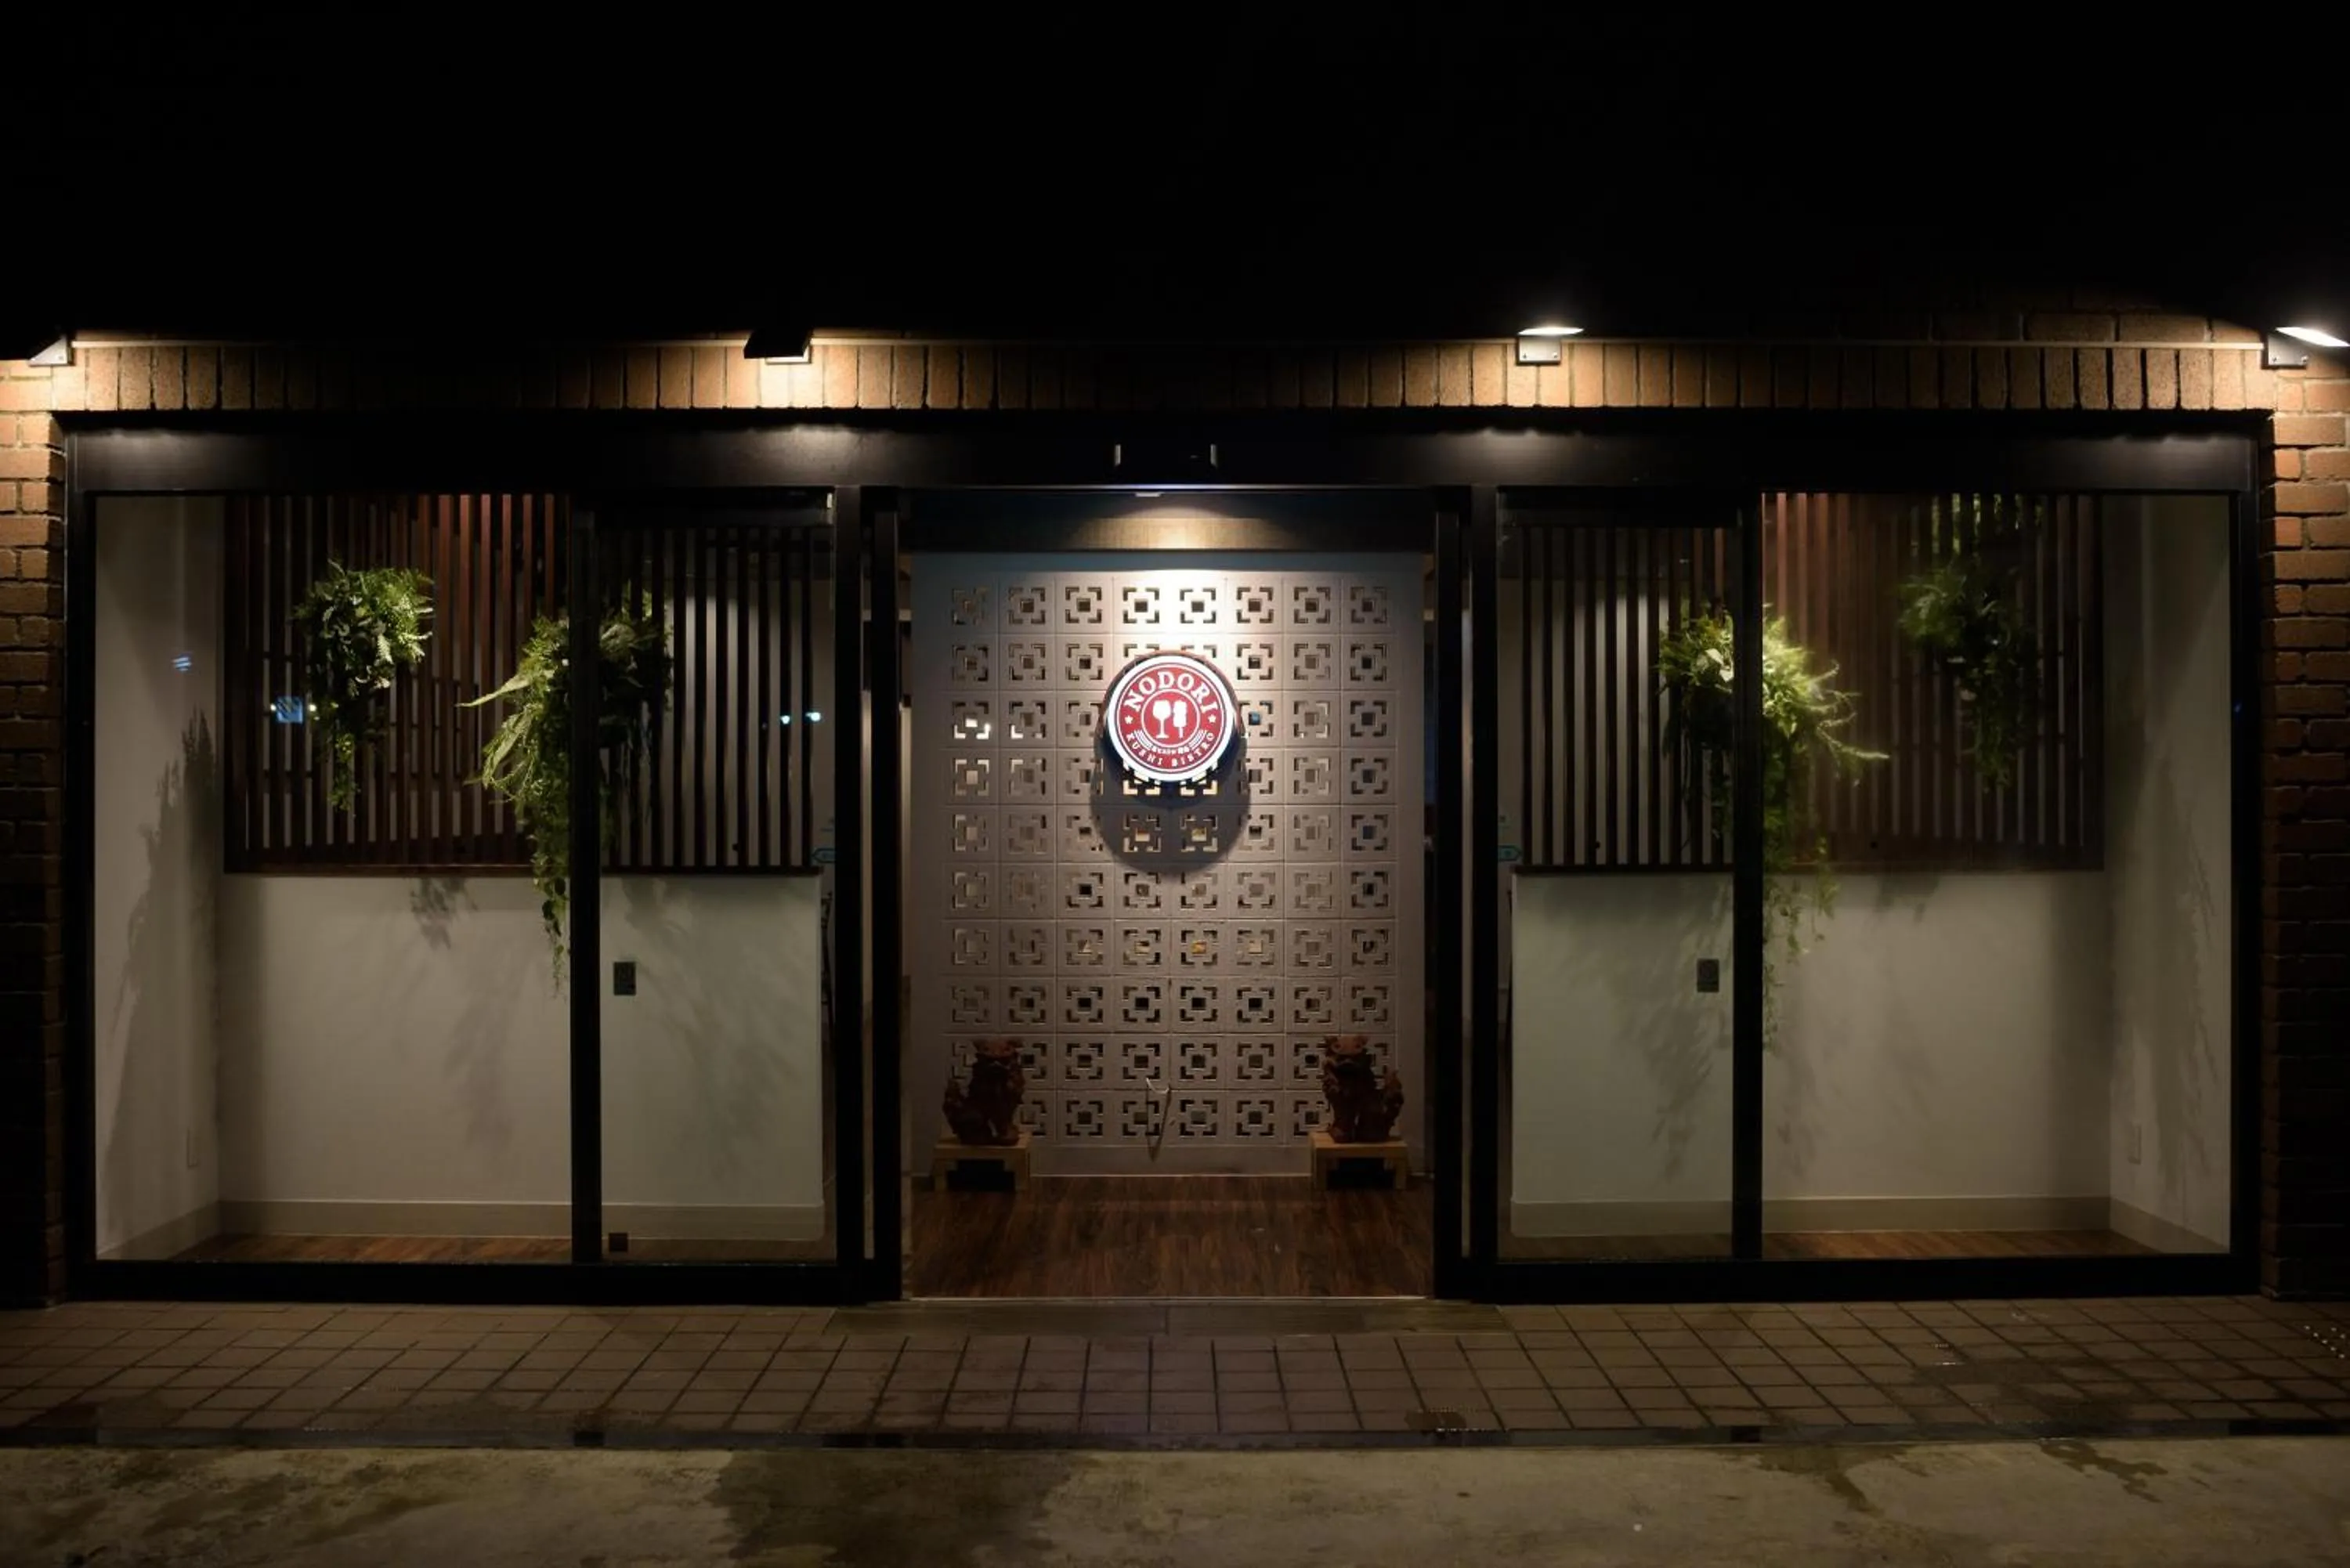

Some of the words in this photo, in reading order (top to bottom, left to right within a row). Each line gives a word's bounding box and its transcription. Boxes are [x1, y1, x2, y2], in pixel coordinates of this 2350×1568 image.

[1123, 671, 1218, 714] NODORI
[1126, 732, 1163, 765] KUSHI
[1171, 732, 1215, 767] BISTRO
